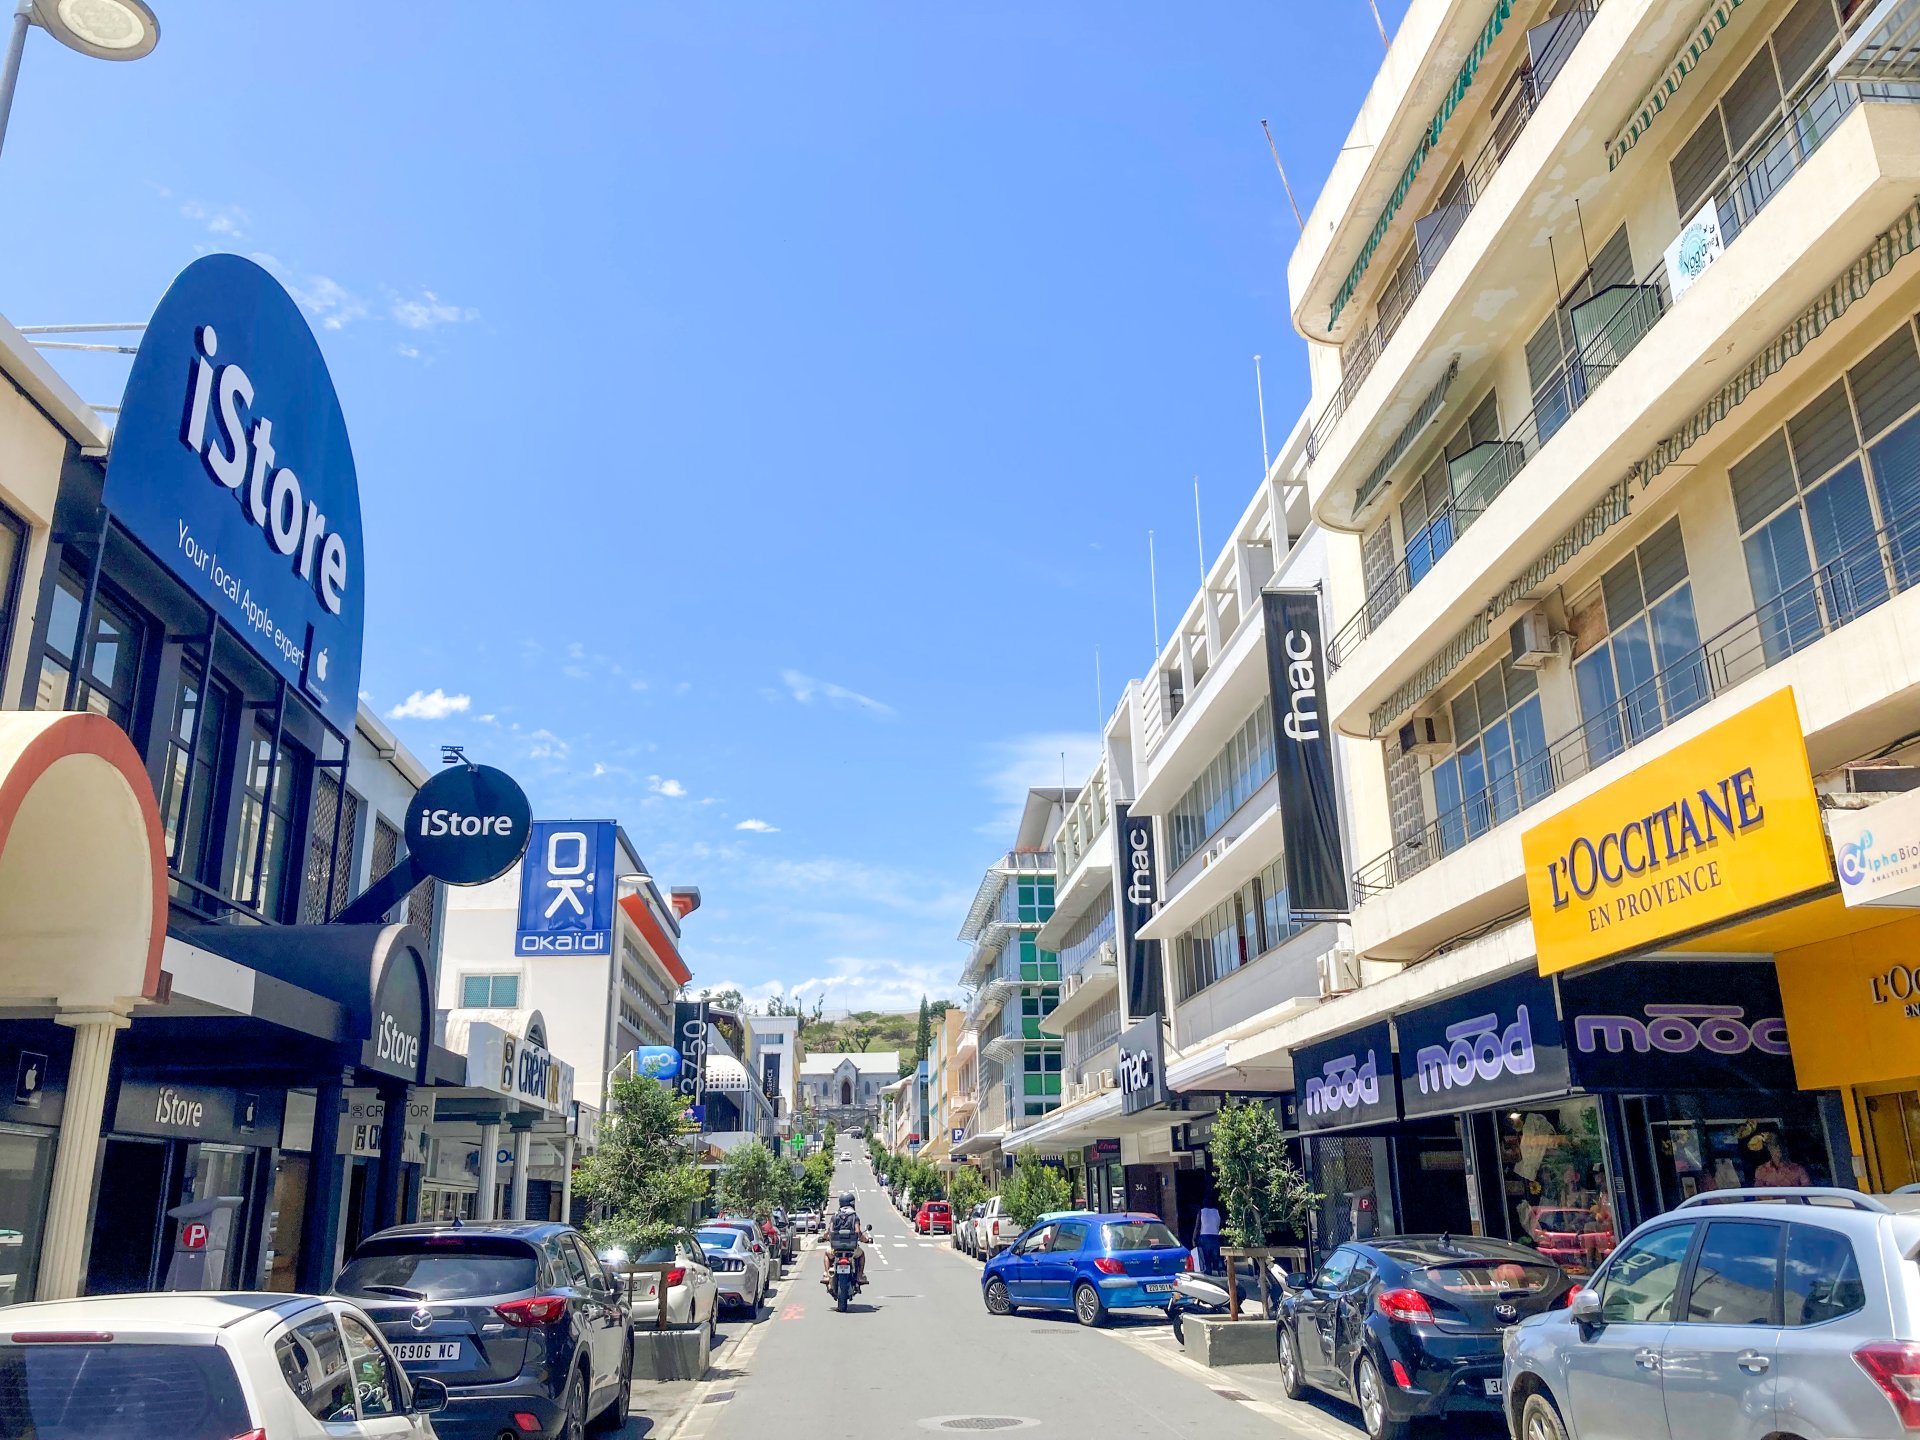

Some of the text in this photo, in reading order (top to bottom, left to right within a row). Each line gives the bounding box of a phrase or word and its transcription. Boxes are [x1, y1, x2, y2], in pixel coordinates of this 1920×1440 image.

[188, 325, 347, 615] iStore
[178, 518, 304, 671] Your local Apple expert
[1284, 629, 1319, 742] fnac
[420, 809, 513, 836] iStore
[1547, 767, 1764, 908] L'OCCITANE
[1128, 828, 1151, 905] fnac
[1588, 860, 1722, 933] EN PROVENCE
[521, 932, 604, 951] okaïdi
[377, 1011, 418, 1068] iStore
[681, 1020, 707, 1094] 3750
[1119, 1047, 1148, 1095] fnac
[155, 1087, 203, 1128] iStore
[954, 1129, 963, 1140] P
[1361, 1199, 1369, 1209] P
[189, 1225, 205, 1247] P
[649, 1285, 656, 1295] A
[438, 1344, 453, 1358] NC
[1490, 1380, 1502, 1393] 3
